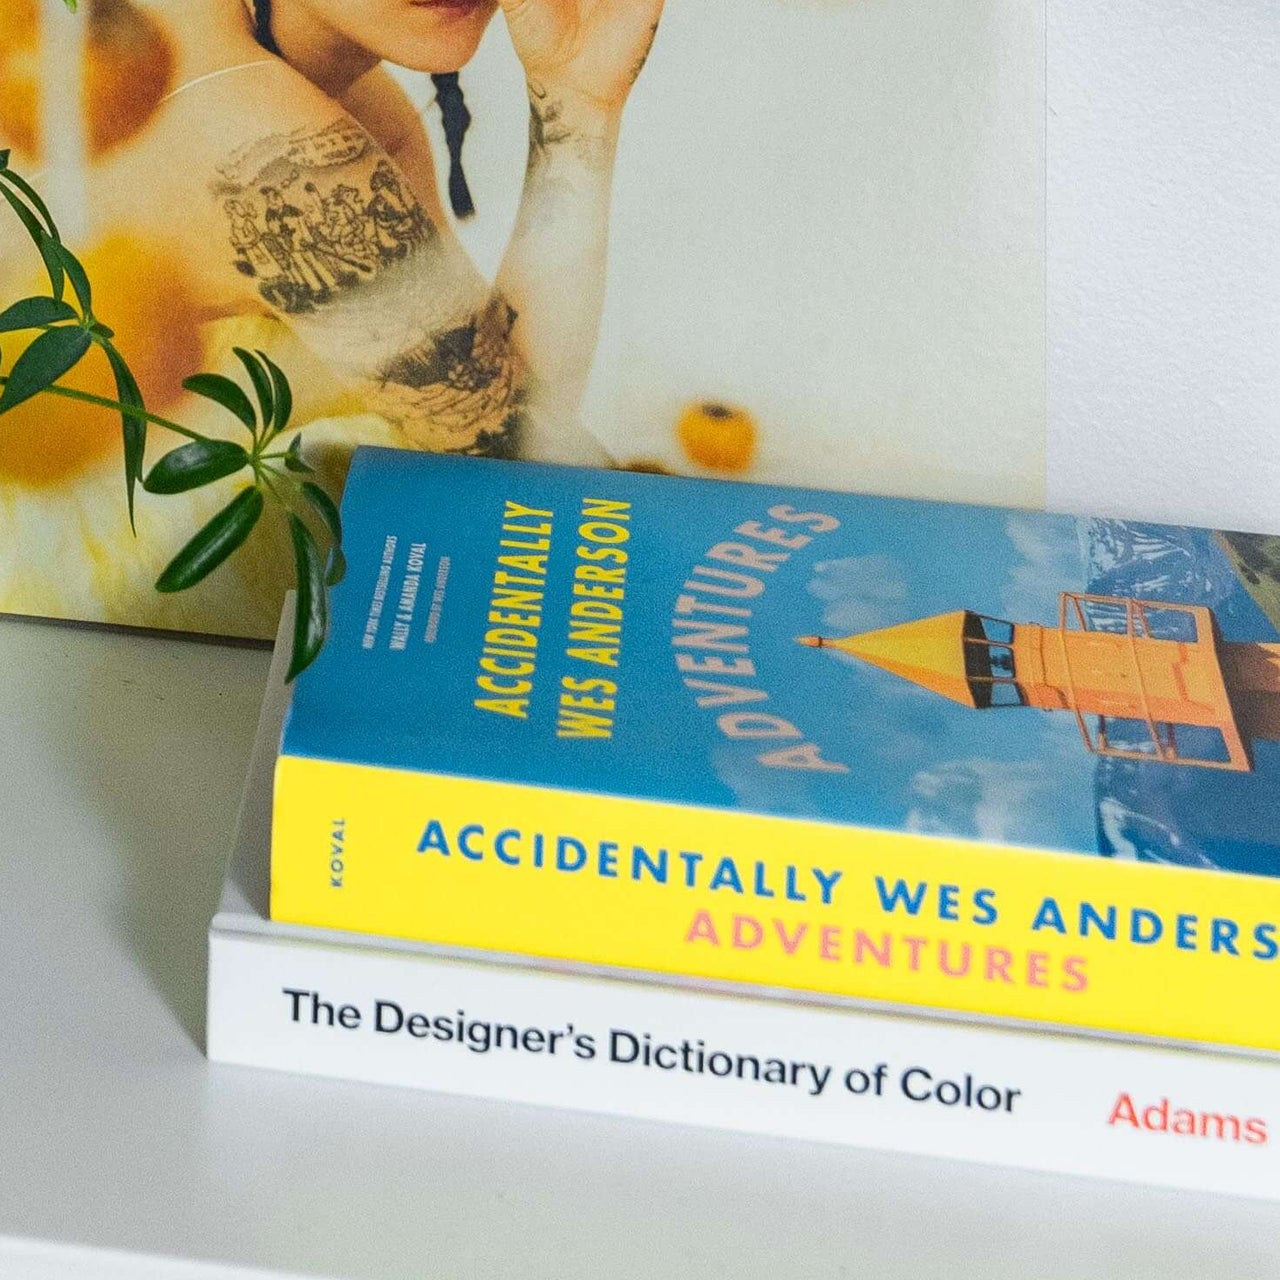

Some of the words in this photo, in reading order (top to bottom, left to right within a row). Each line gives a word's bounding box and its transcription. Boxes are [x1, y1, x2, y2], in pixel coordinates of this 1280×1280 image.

[398, 574, 421, 612] AMANDA
[406, 543, 427, 572] KOVAL
[567, 498, 631, 667] ANDERSON
[389, 620, 411, 650] WALLY
[474, 501, 554, 719] ACCIDENTALLY
[674, 505, 845, 772] ADVENTURES
[558, 676, 618, 738] WES
[328, 816, 347, 889] KOVAL
[417, 820, 841, 905] ACCIDENTALLY
[875, 877, 998, 926] WES
[685, 909, 1090, 994] ADVENTURES
[282, 989, 362, 1030] The
[374, 1001, 597, 1060] Designer’s
[609, 1030, 832, 1097] Dictionary
[844, 1064, 888, 1096] of
[900, 1068, 1022, 1113] Color
[1108, 1092, 1270, 1144] Adams
